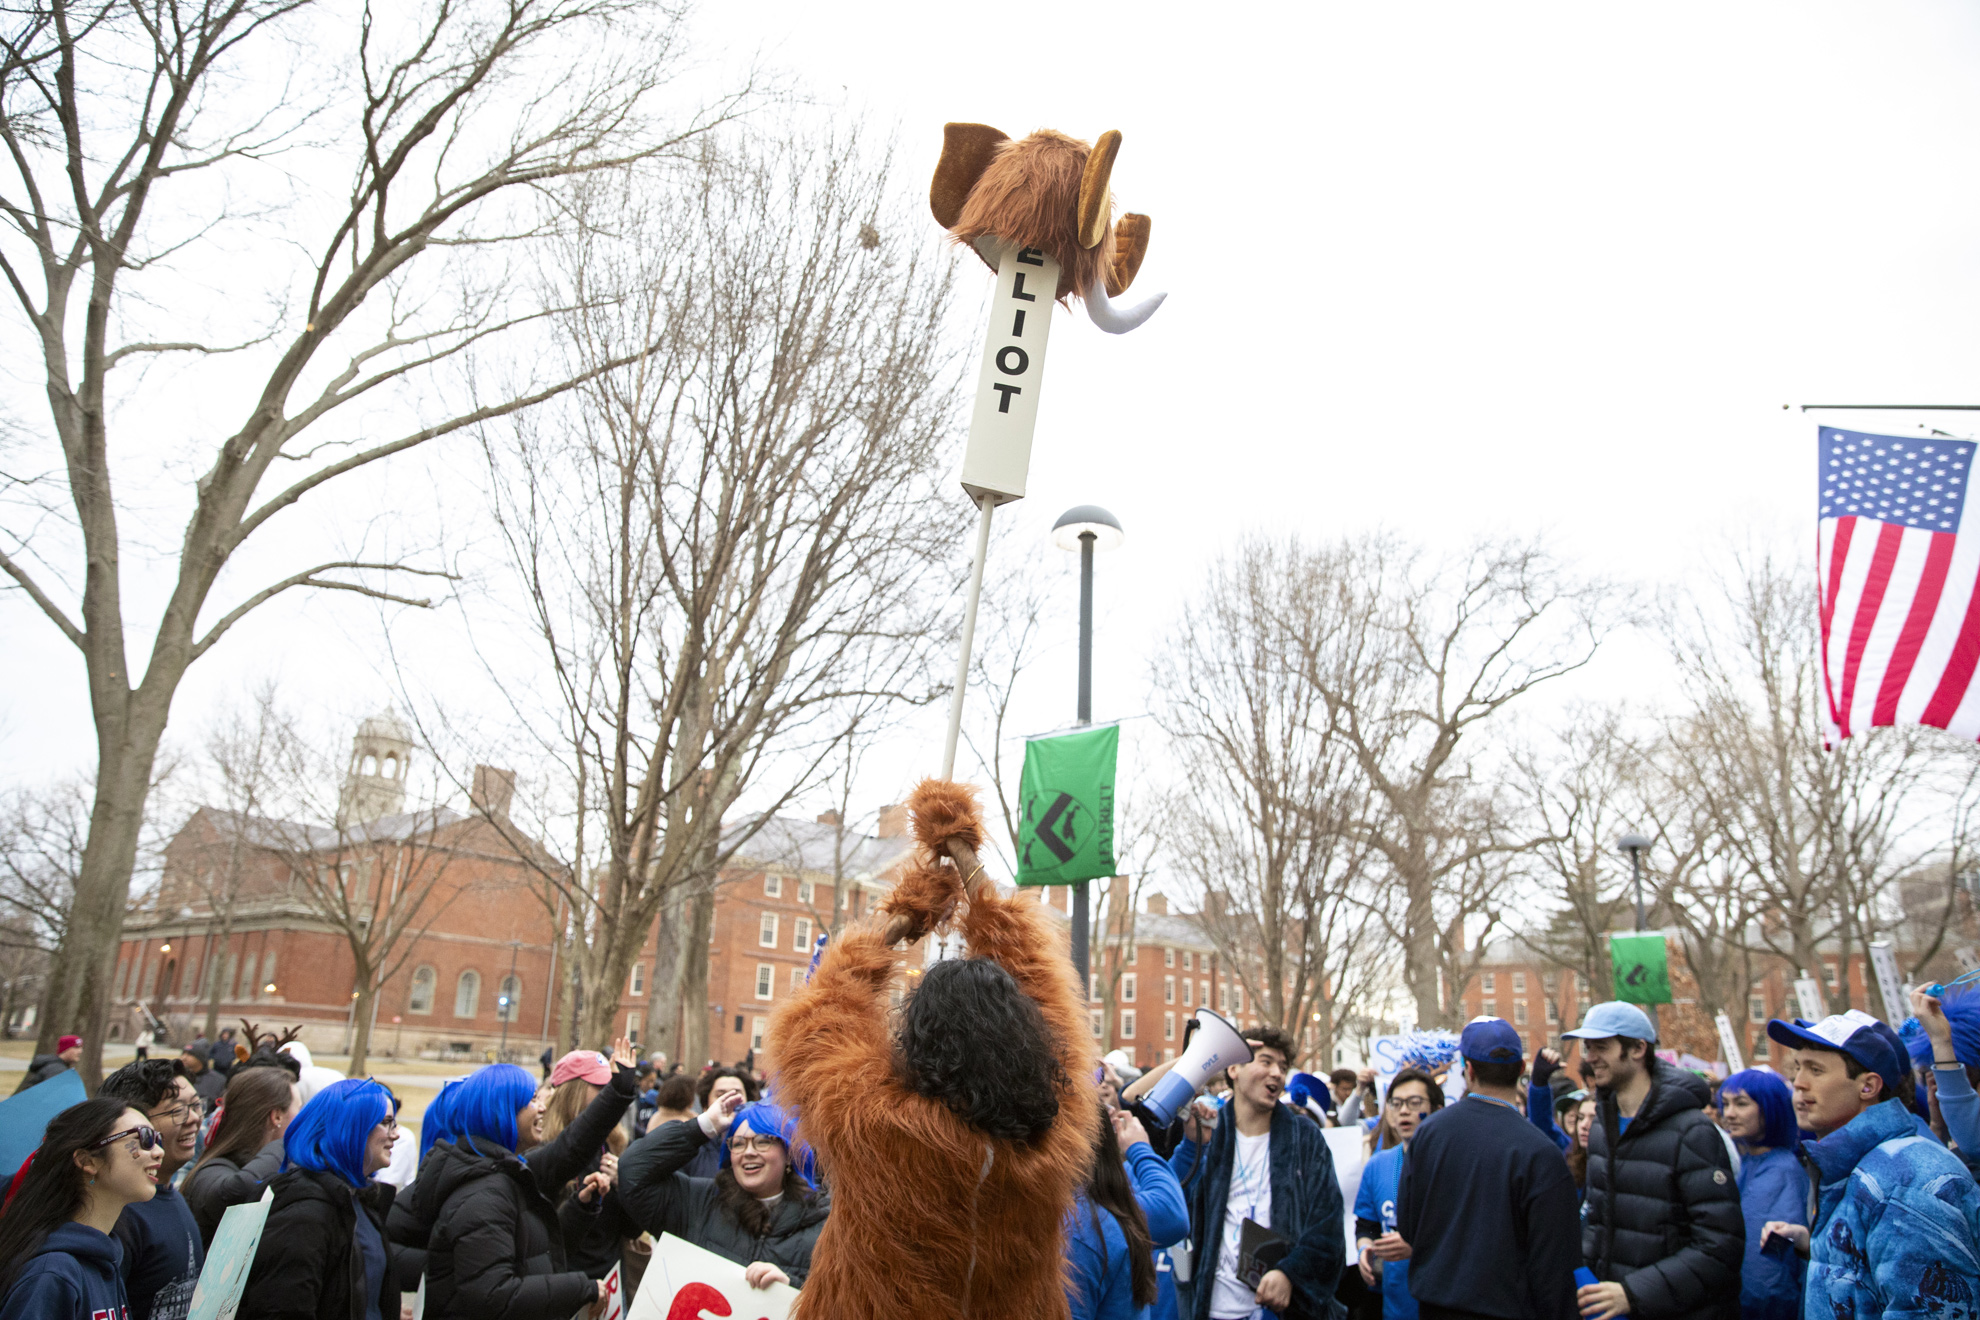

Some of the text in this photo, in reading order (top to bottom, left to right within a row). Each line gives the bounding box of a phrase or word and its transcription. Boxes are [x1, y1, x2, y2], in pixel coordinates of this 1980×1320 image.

[993, 246, 1044, 414] ELIOT
[1100, 783, 1112, 865] LEVERETT
[1201, 1053, 1219, 1072] PYLE
